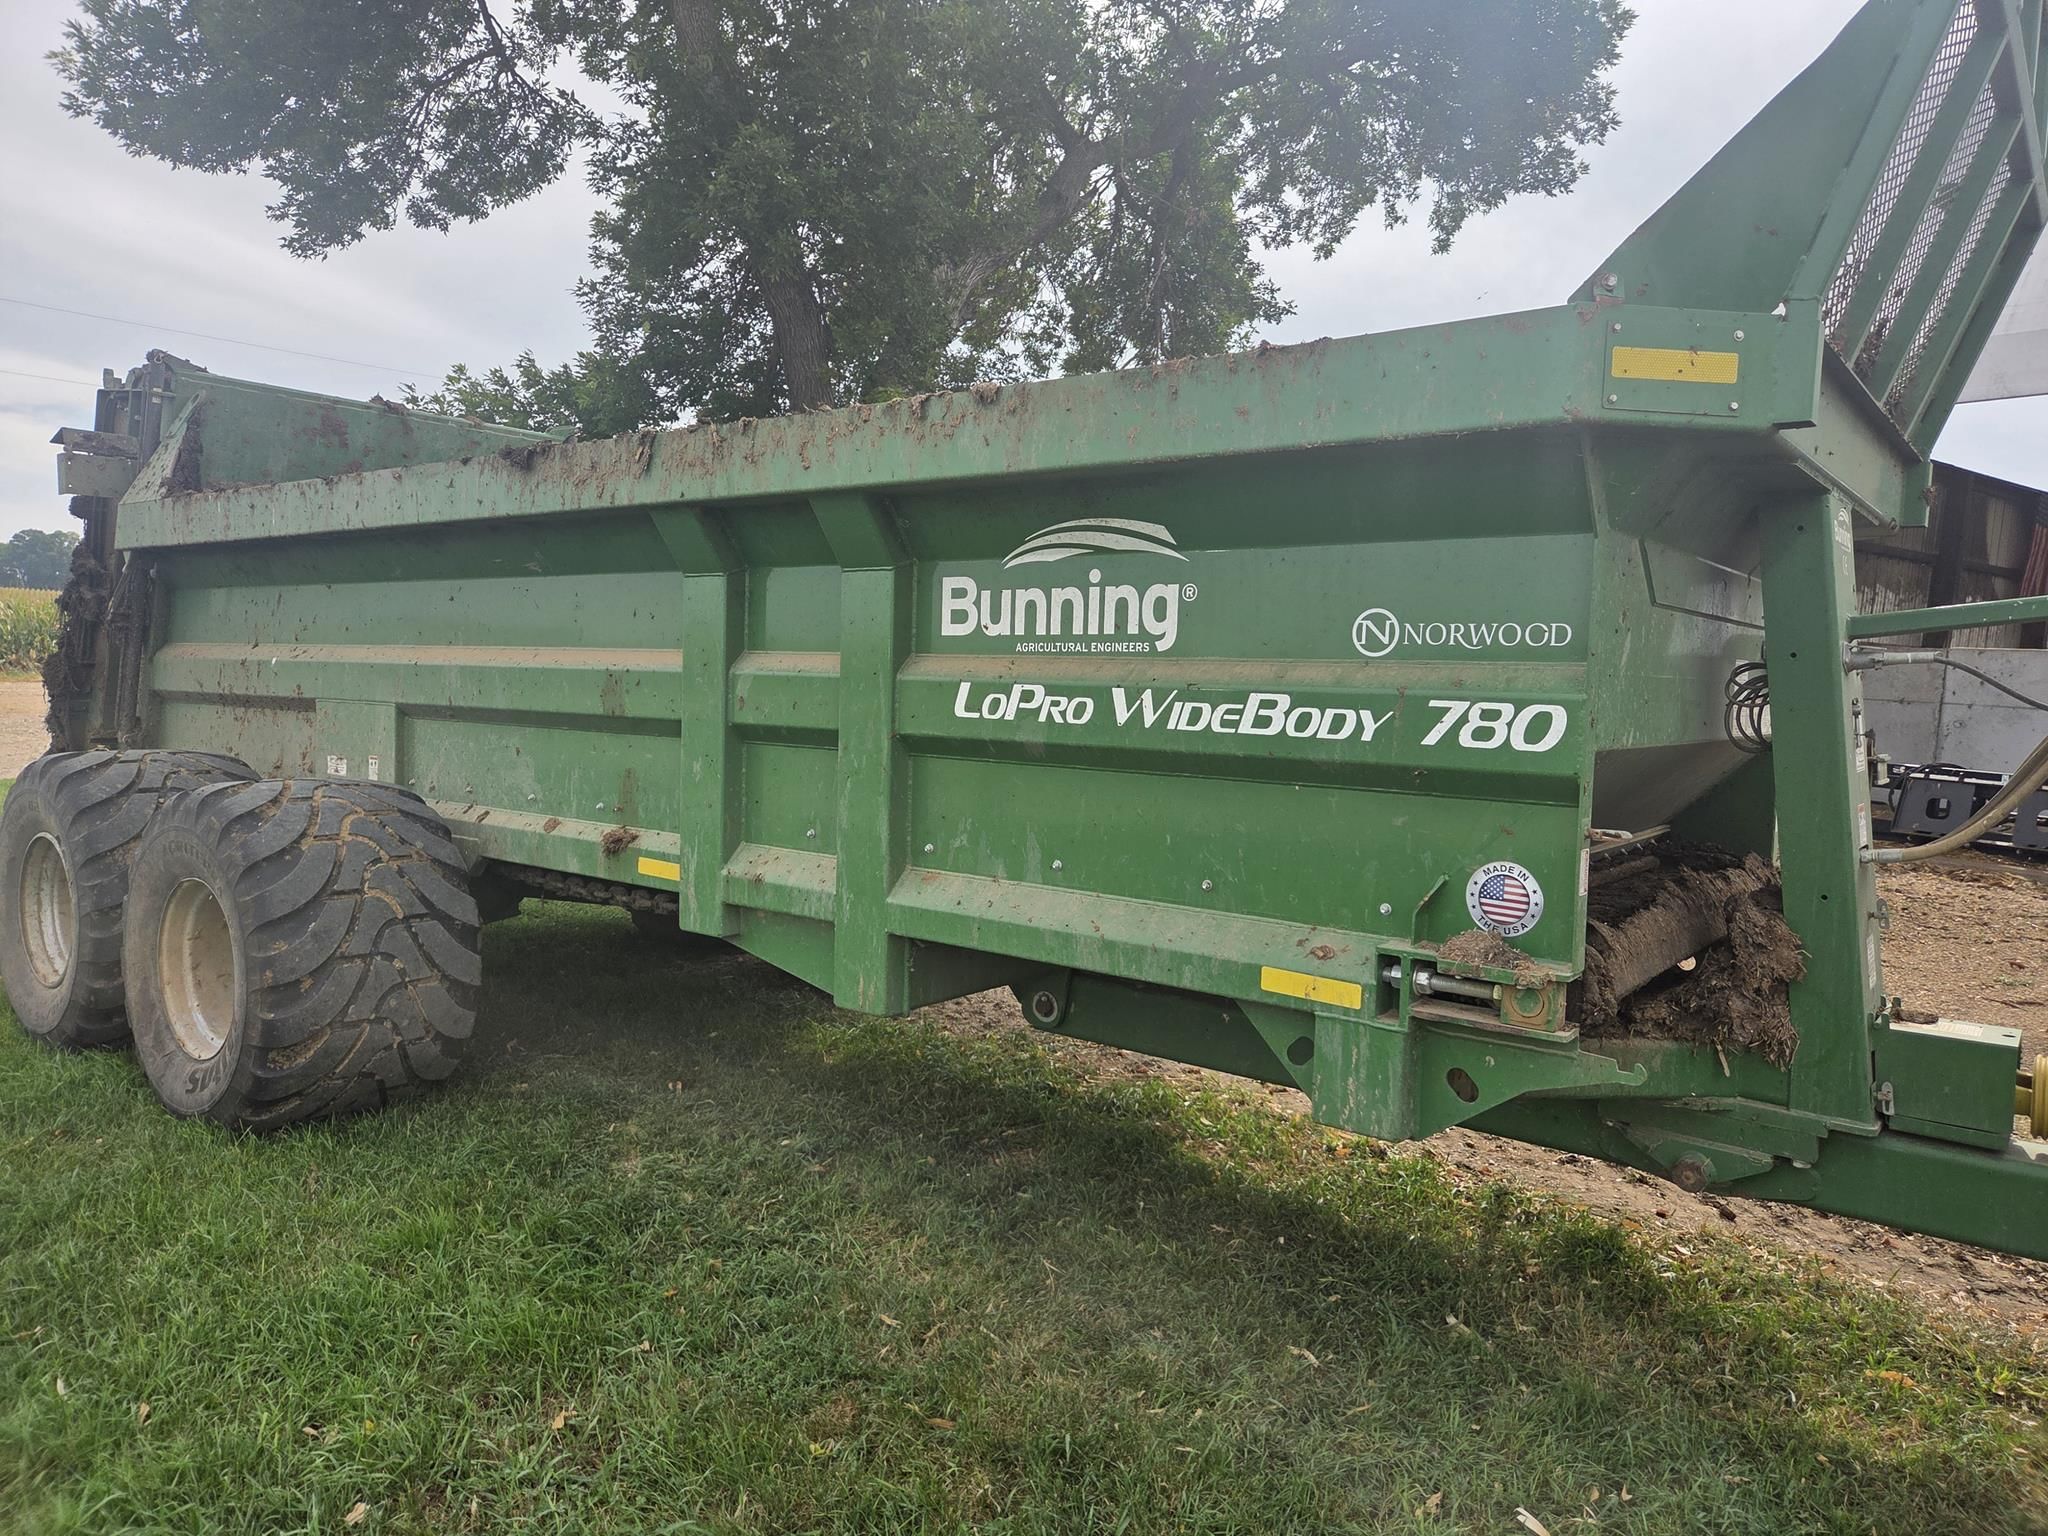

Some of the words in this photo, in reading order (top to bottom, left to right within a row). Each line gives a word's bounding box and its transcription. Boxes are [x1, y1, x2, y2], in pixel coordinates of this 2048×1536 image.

[1015, 642, 1089, 652] AGRICULTURAL
[1090, 642, 1150, 652] ENGINEERS
[1402, 622, 1573, 650] NORWOOD
[1419, 699, 1568, 752] 780
[1482, 864, 1516, 877] MADE
[1517, 870, 1530, 882] IN
[1477, 914, 1500, 933] THE
[1503, 922, 1529, 936] USA
